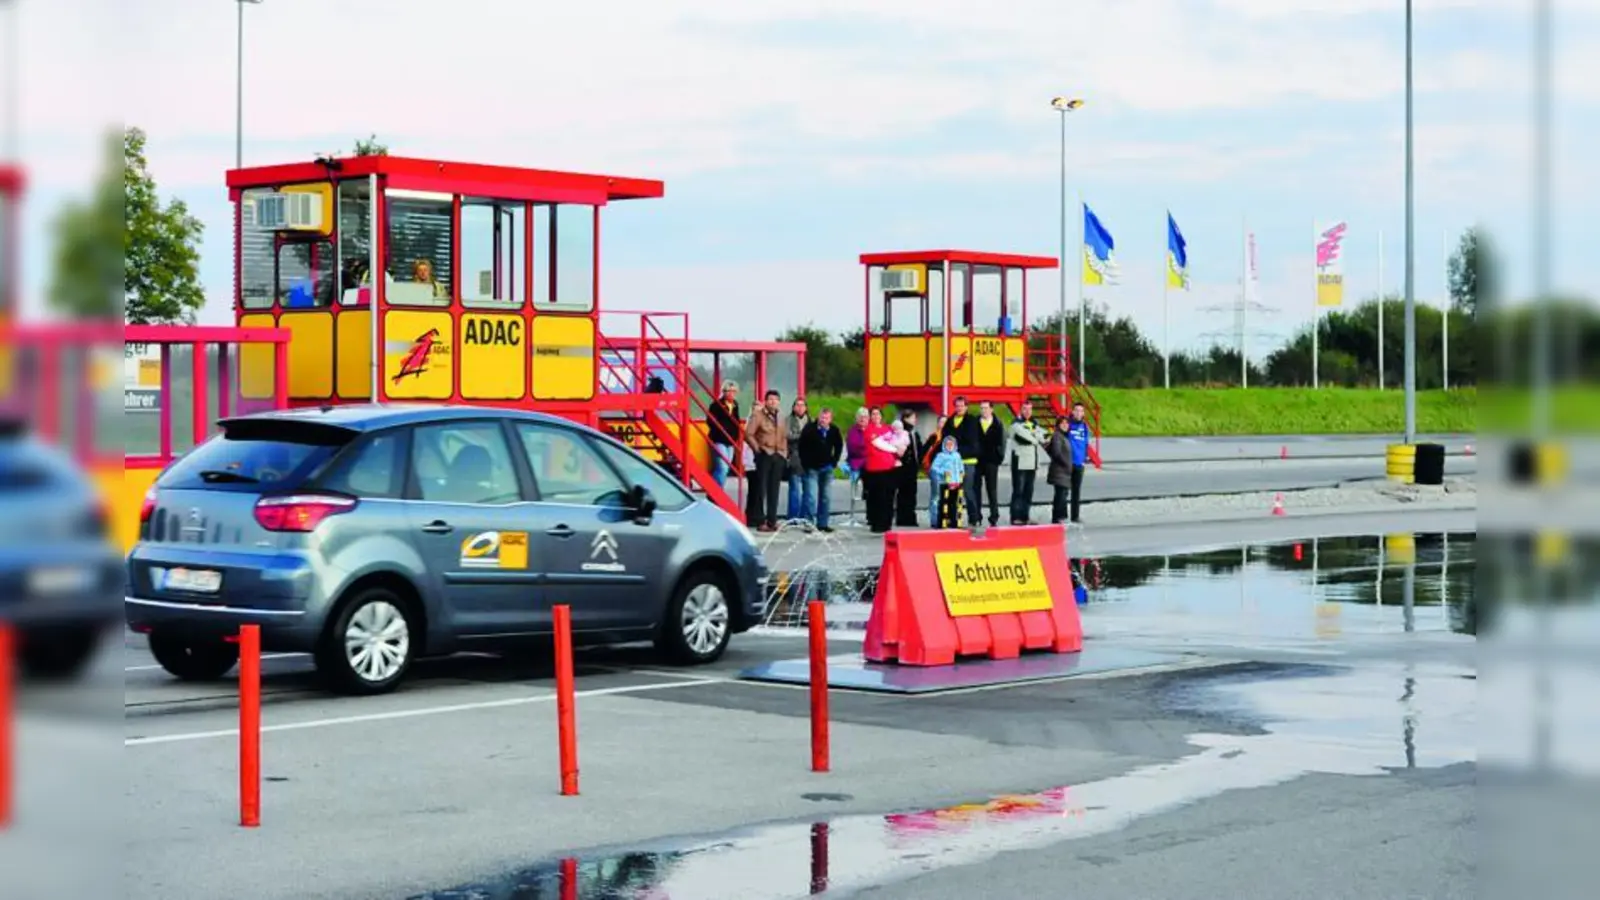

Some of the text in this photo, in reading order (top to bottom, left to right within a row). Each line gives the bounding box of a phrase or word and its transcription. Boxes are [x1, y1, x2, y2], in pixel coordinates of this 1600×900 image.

[464, 319, 521, 345] ADAC
[975, 340, 1001, 356] ADAC
[954, 560, 1031, 585] Achtung!
